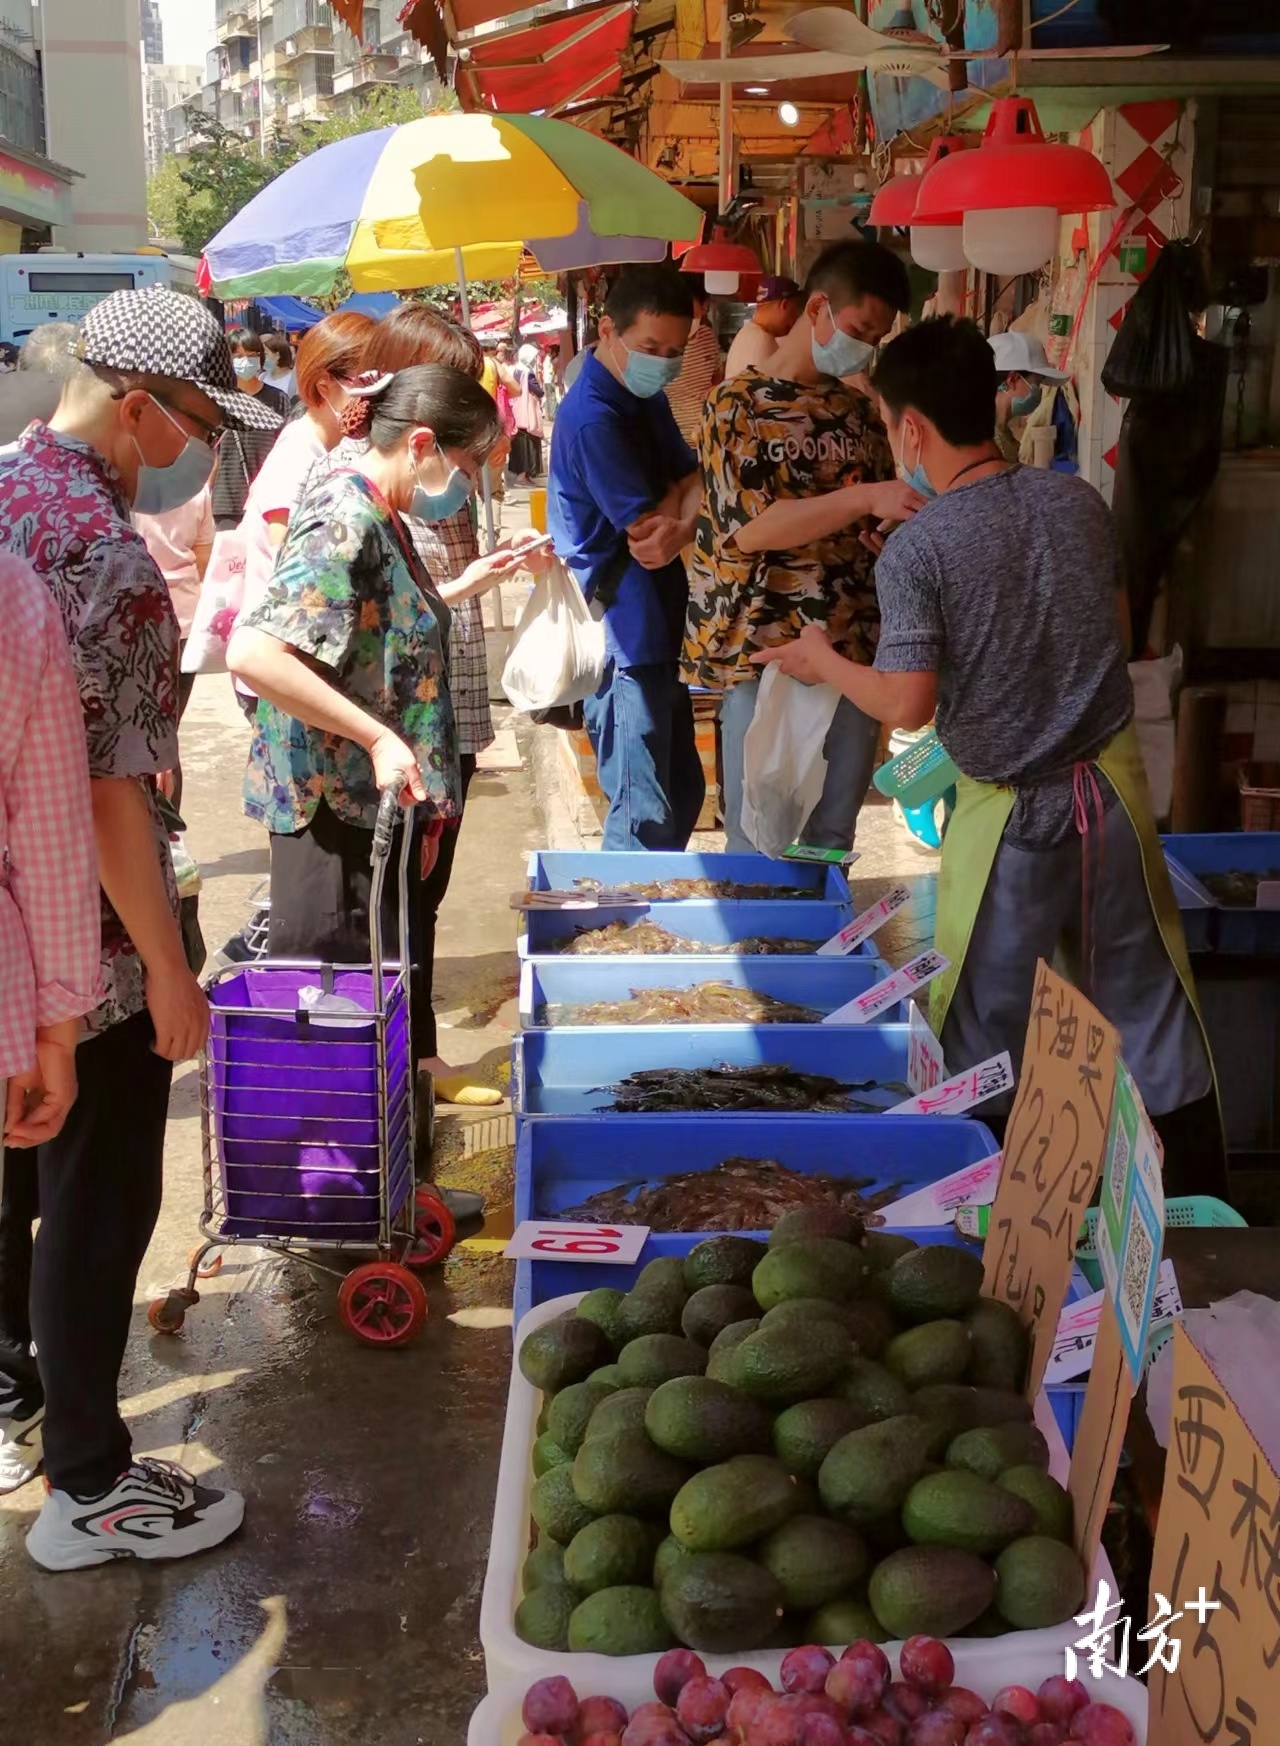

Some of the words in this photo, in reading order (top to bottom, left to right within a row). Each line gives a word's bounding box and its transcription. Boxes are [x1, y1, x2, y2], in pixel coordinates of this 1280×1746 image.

[1033, 969, 1105, 1129] 牛油果
[531, 1228, 624, 1254] 19
